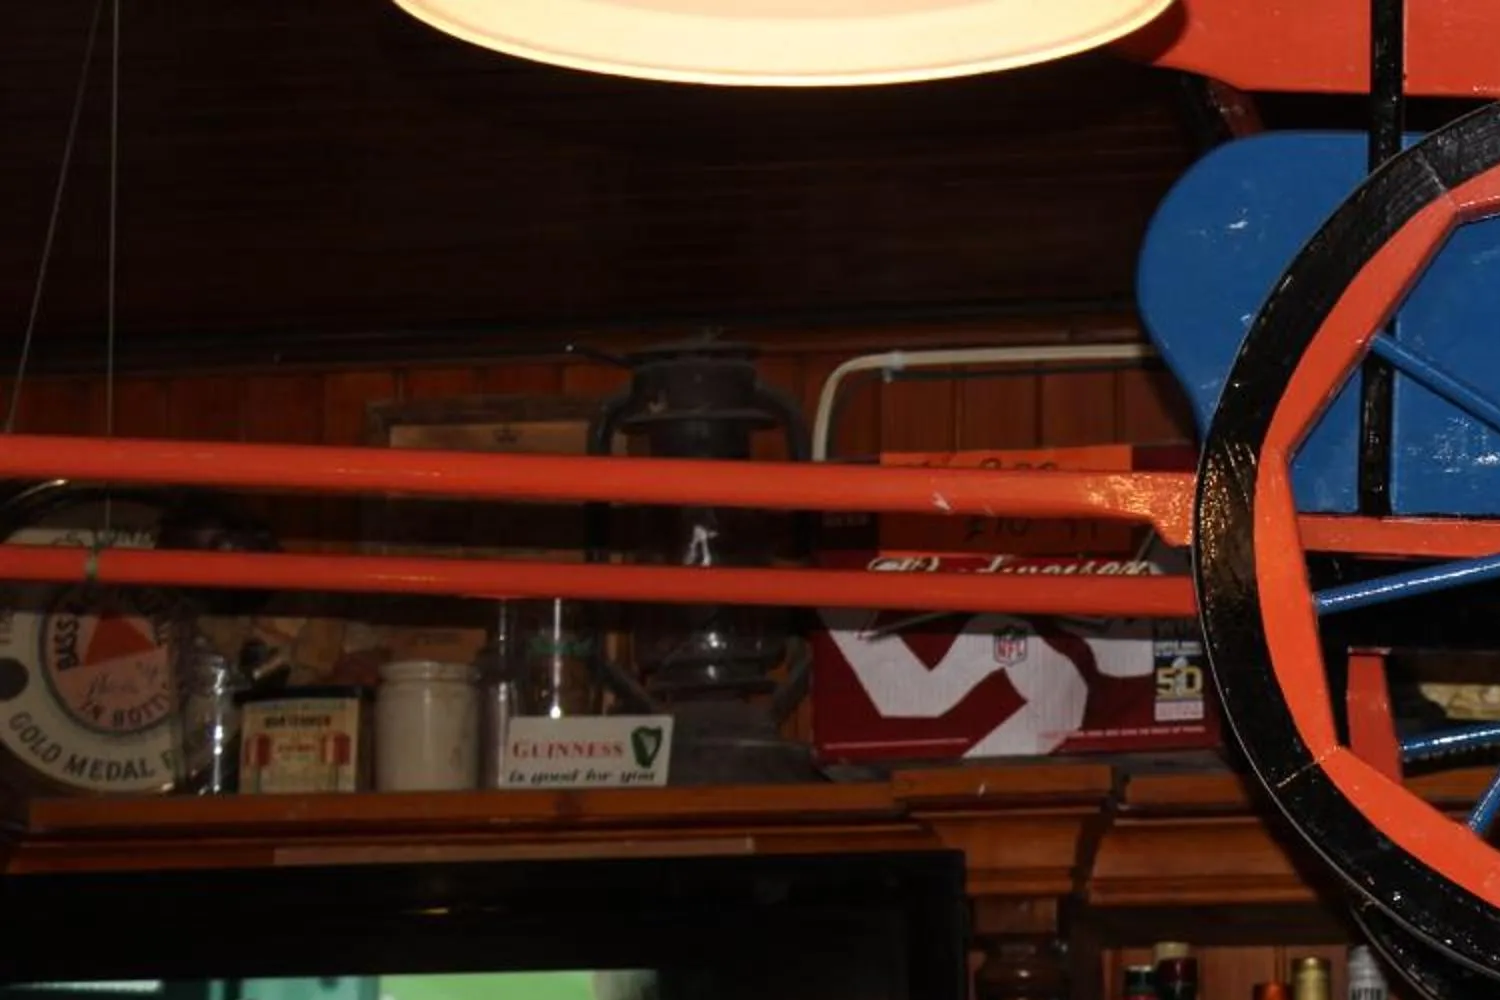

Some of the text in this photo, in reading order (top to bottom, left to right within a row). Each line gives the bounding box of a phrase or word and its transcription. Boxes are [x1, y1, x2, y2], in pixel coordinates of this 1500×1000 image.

[1155, 665, 1204, 698] 50
[9, 711, 63, 763] GOLD
[63, 754, 157, 782] MEDAL
[512, 741, 626, 760] GUINNESS
[530, 767, 579, 785] good
[619, 770, 657, 785] you
